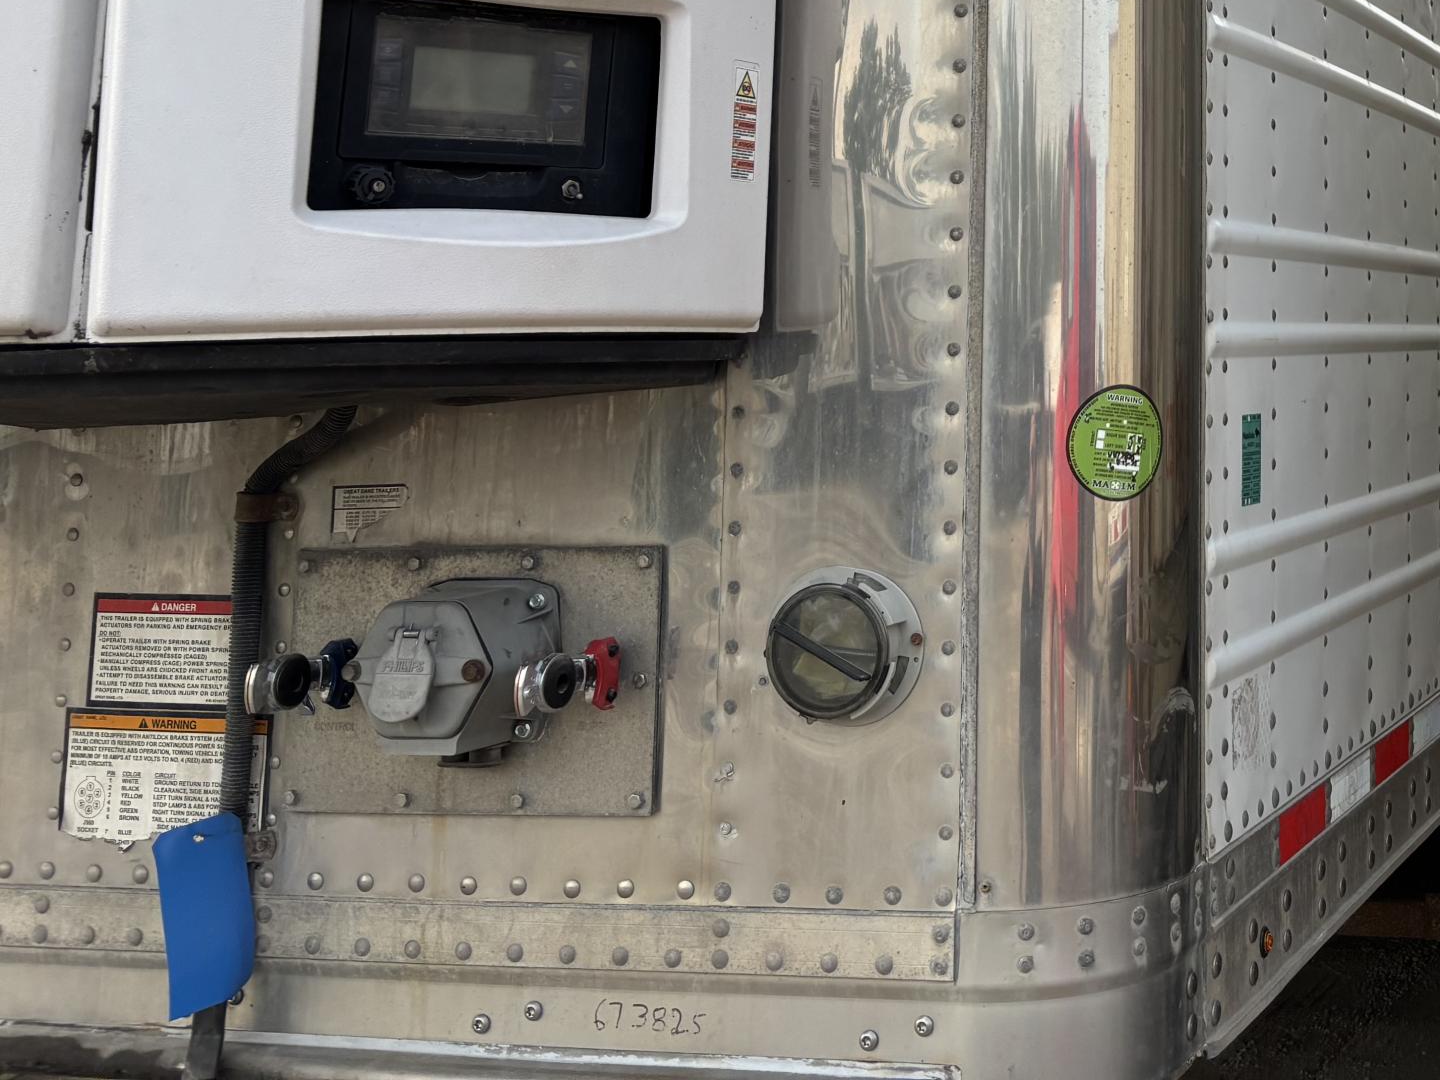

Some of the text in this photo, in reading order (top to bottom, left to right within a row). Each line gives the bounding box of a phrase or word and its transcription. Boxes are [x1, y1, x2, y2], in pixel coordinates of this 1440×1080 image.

[1106, 393, 1143, 405] WARNING
[1091, 479, 1136, 491] MAXIM
[161, 602, 197, 612] DANGER
[183, 653, 208, 661] (CAGED)
[124, 688, 150, 696] DAMAGE,
[151, 718, 198, 730] WARNING
[71, 730, 94, 738] TRAILER
[100, 731, 127, 739] EQUIPPED
[71, 738, 89, 746] (BLUE)
[89, 738, 110, 746] CIRCUIT
[117, 739, 146, 747] RESERVED
[158, 741, 194, 749] CONTINUOUS
[98, 746, 126, 754] EFFECTIVE
[139, 748, 171, 756] OPERATION,
[184, 757, 201, 765] (RED)
[121, 770, 142, 778] COLOR
[153, 786, 188, 795] CLEARANCE,
[121, 792, 144, 800] YELLOW
[152, 801, 167, 809] STOP
[168, 802, 187, 810] LAMPS
[77, 826, 99, 834] SOCKET
[593, 998, 707, 1036] 673825
